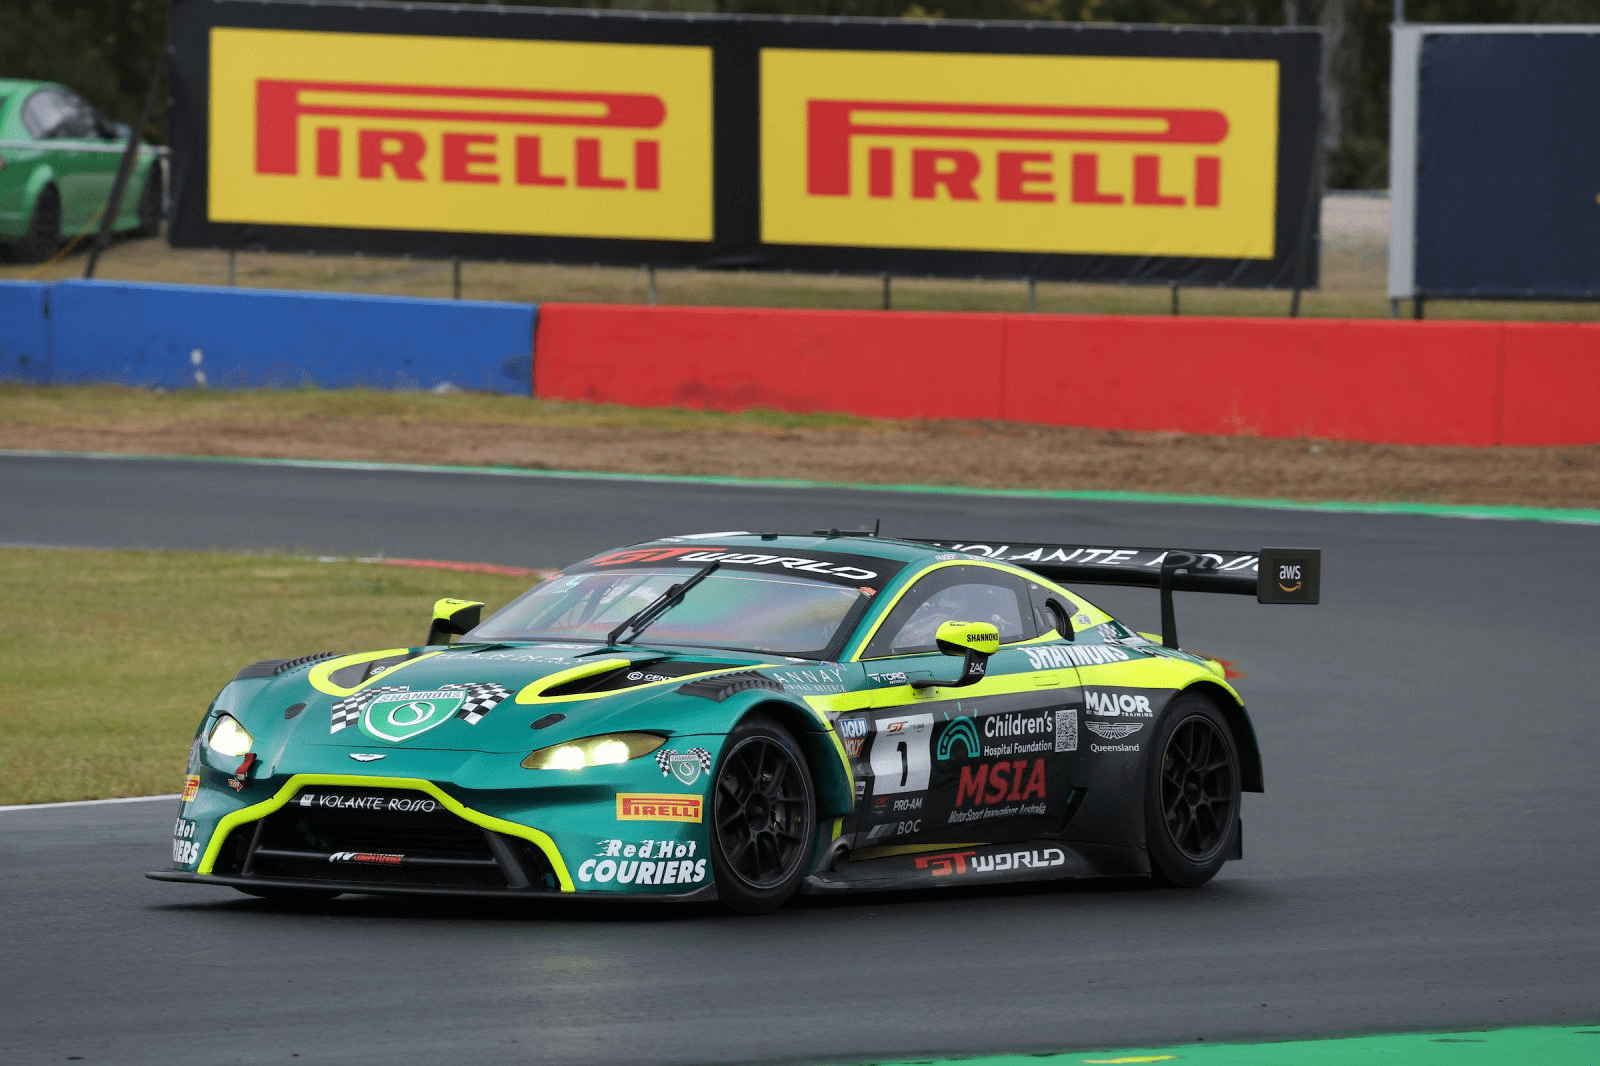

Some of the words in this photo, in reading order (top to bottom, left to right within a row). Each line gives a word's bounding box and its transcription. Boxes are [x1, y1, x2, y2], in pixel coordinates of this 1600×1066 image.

[254, 77, 667, 191] PIRELLI
[806, 98, 1230, 207] PIRELLI
[1279, 565, 1301, 580] aws
[966, 633, 999, 642] SHANNONS
[1018, 645, 1129, 669] SHANNONS
[380, 691, 461, 702] SHANNONS
[1085, 691, 1152, 716] MAJOR
[984, 711, 1053, 738] Children's
[984, 744, 1012, 758] Hospital
[1014, 740, 1053, 754] Foundation
[1090, 743, 1140, 753] Queensland
[896, 741, 909, 786] 1
[955, 759, 1046, 807] MSIA
[319, 795, 384, 810] VOLANTE
[622, 798, 701, 818] PIRELLI
[893, 798, 923, 811] PRO-AM
[897, 819, 922, 835] BOC
[599, 839, 654, 859] Red
[657, 840, 697, 858] Hot
[971, 848, 1065, 872] WORLD
[578, 859, 707, 884] COURIERS
